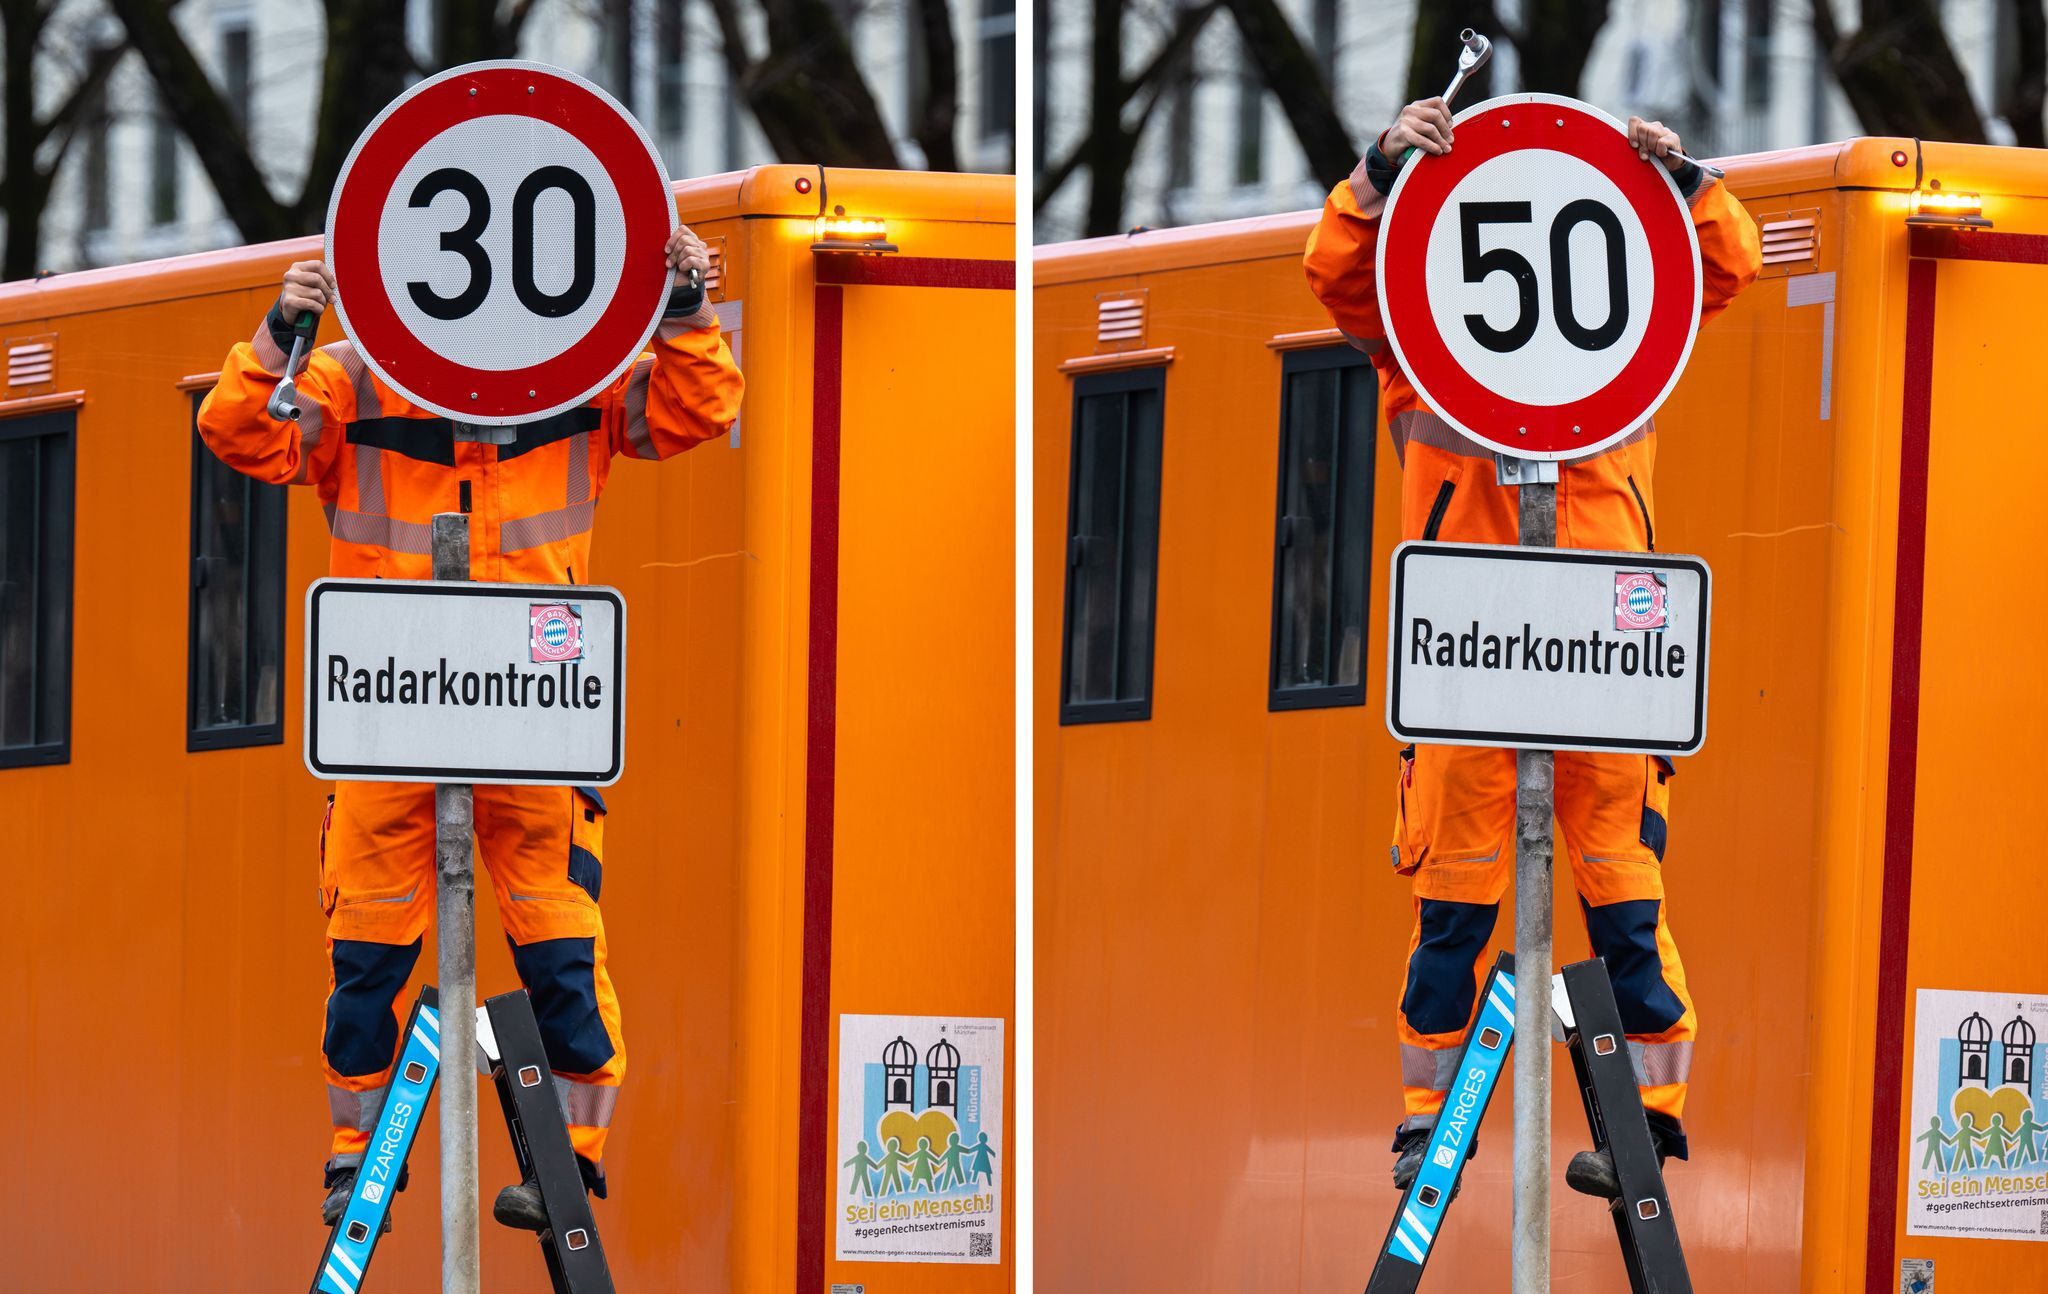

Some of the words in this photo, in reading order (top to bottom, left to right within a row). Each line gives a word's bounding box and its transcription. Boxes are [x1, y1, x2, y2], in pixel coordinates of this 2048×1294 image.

[406, 165, 596, 321] 30
[1459, 198, 1630, 353] 50
[1411, 617, 1685, 679] Radarkontrolle
[327, 654, 602, 710] Radarkontrolle
[967, 1068, 979, 1124] München
[1441, 1067, 1486, 1147] ZARGES
[370, 1101, 412, 1182] ZARGES
[846, 1202, 875, 1224] Sei
[879, 1200, 910, 1220] ein
[913, 1193, 992, 1217] Mensch!
[1918, 1177, 1946, 1198] Sei
[1950, 1176, 1981, 1196] ein
[842, 1249, 966, 1258] www.muenchen-gegen-rechtsextremismus.de
[855, 1218, 986, 1239] #gegenRechtsextremismus
[1913, 1223, 2036, 1235] www.muenchen-gegen-rechtsextremismus.de
